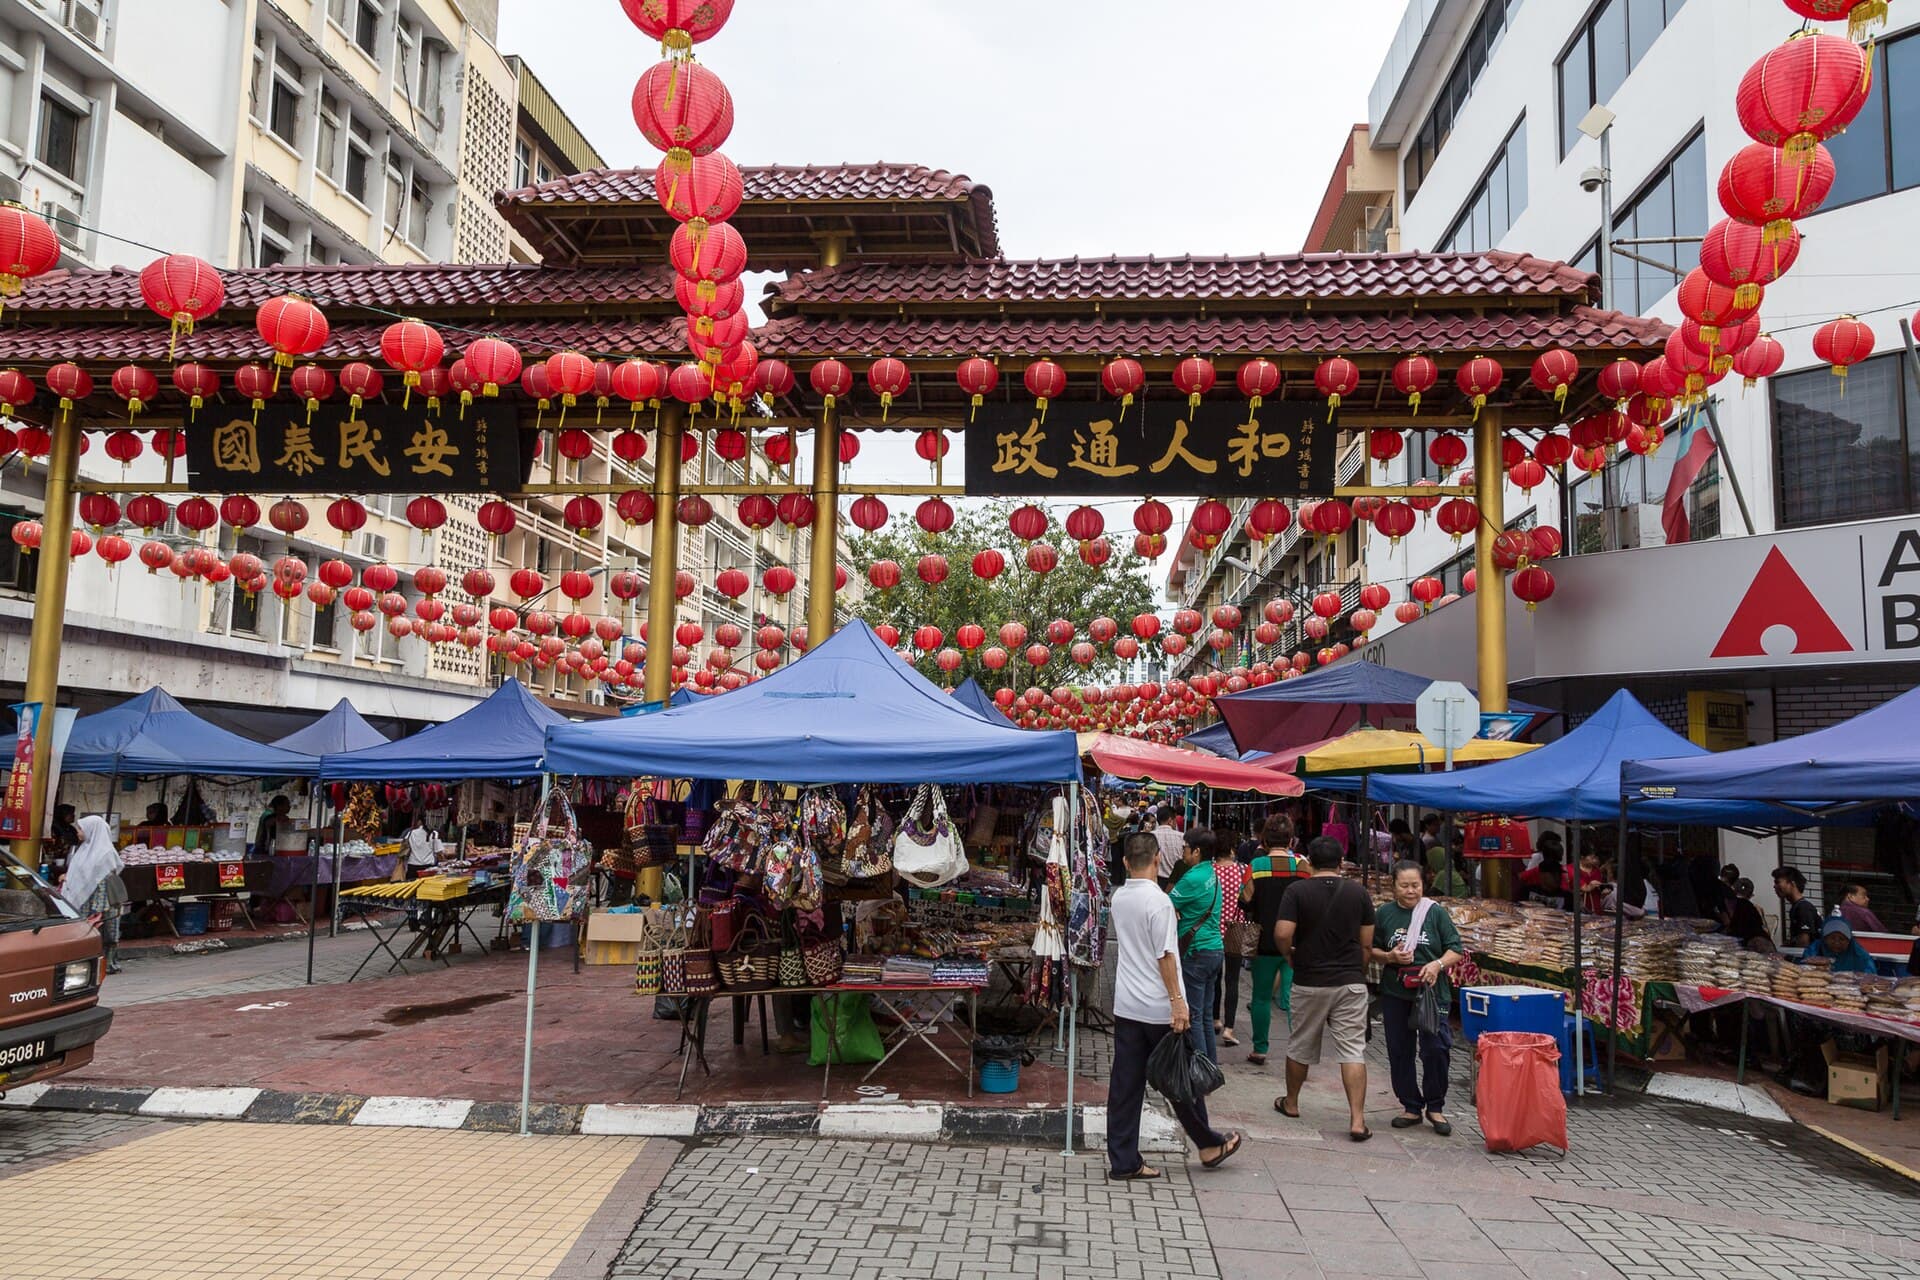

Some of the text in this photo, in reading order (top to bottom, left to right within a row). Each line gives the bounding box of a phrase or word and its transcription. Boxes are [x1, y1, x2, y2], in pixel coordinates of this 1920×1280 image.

[213, 418, 460, 477] 國泰民安
[992, 418, 1291, 479] 政通人和
[9, 987, 48, 1004] TOYOTA
[0, 1040, 46, 1066] 9508 H
